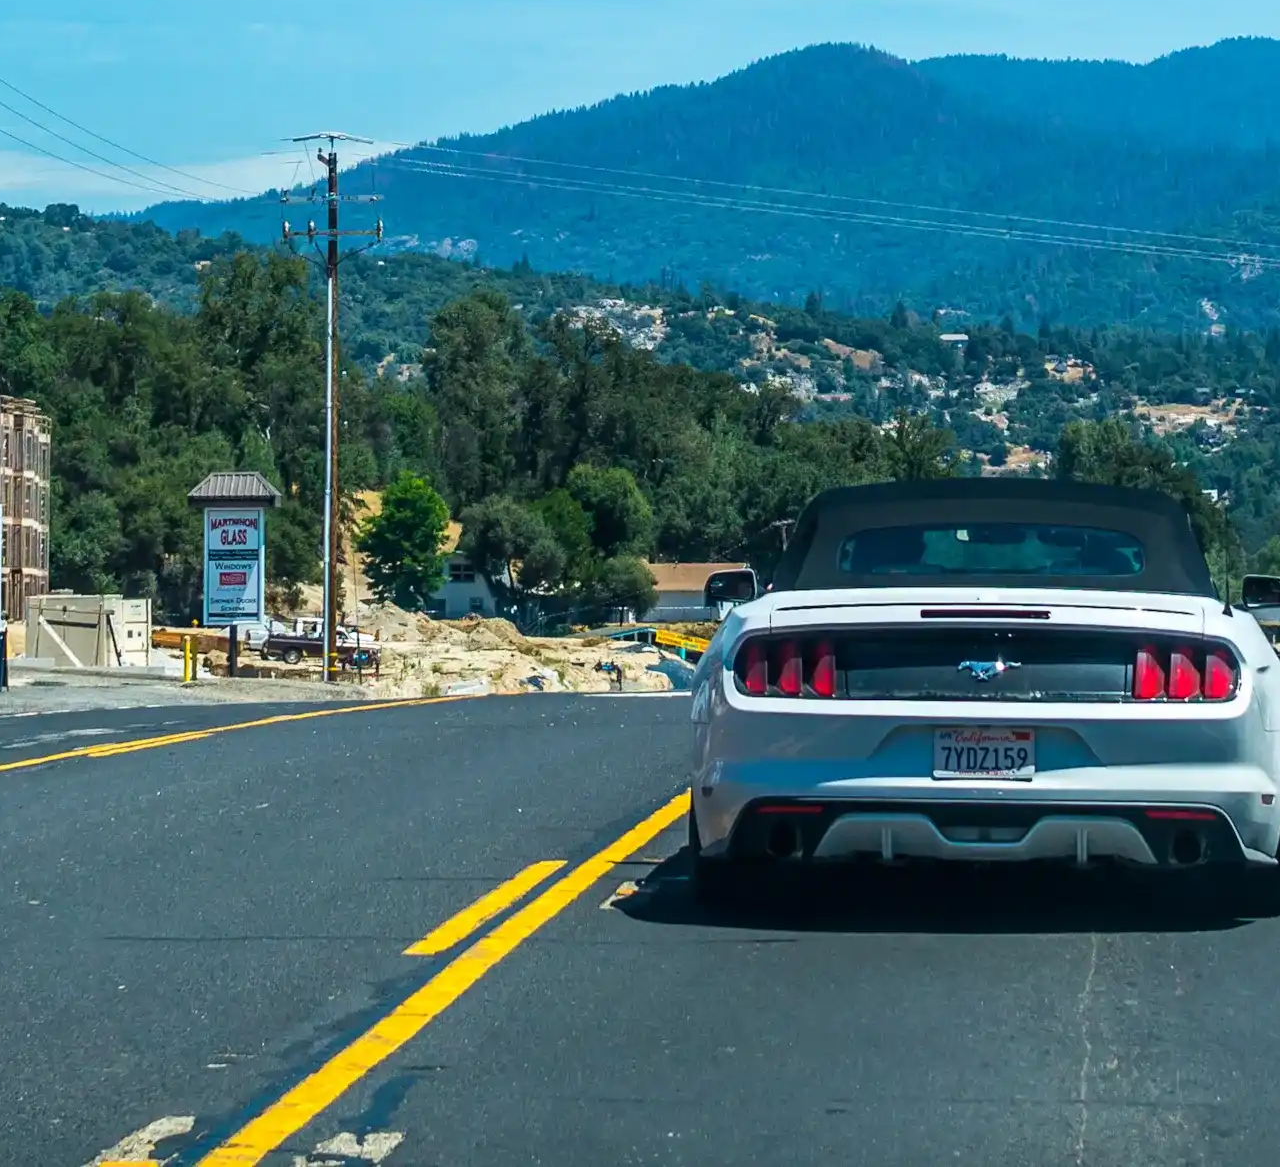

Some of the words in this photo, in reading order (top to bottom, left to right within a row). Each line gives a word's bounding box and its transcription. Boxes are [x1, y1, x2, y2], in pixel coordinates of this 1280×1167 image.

[220, 528, 248, 546] GLASS
[953, 729, 1017, 745] California
[940, 746, 1028, 771] 7YDZ159
